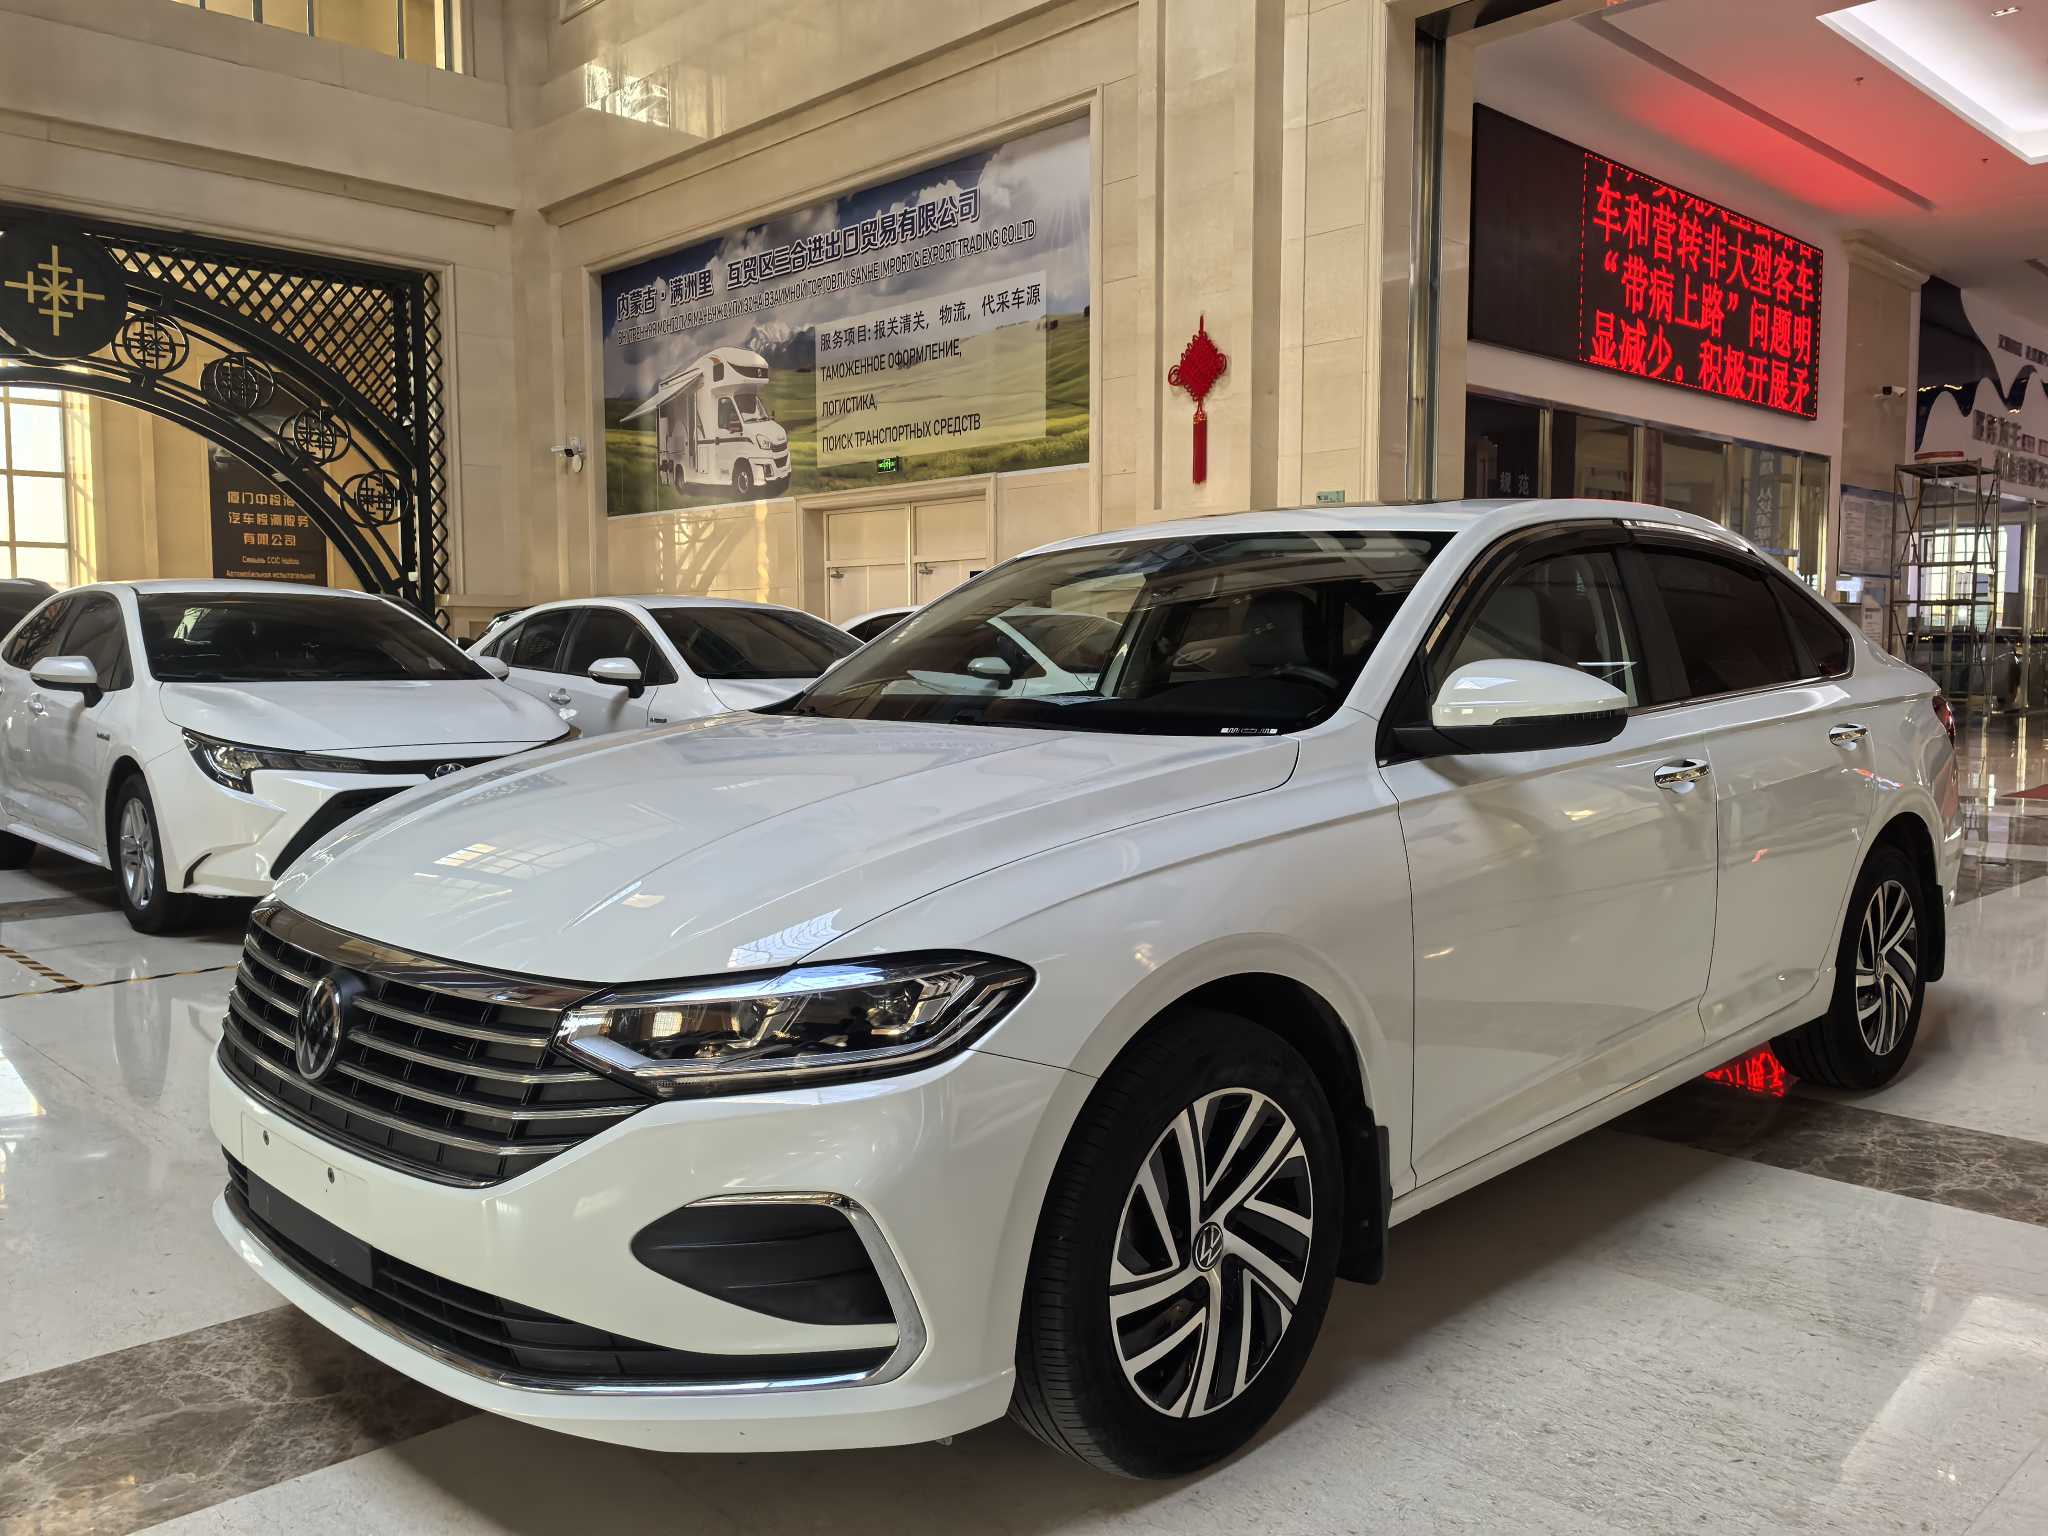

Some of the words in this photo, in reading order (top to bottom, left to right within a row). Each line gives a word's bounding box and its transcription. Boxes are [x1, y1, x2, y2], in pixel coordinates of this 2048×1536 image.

[727, 186, 981, 291] 互贸区三合进出口贸易有限公司
[743, 292, 762, 312] ЗОНА
[763, 278, 805, 307] ВЗАИМНОЙ
[807, 269, 848, 296] ТОРГОВЛИ
[850, 261, 878, 285] SANHE
[879, 252, 911, 278] IMPORT
[913, 249, 920, 268] &
[921, 239, 956, 266] EXPORT
[957, 228, 998, 257] TRADING
[1593, 180, 1814, 311] 车和营转非大型客车
[820, 354, 885, 382] ТАМОЖЕННОЕ
[888, 338, 962, 370] ОФОРМЛЕНИЕ,
[822, 393, 878, 417] ЛОГИСТИКА,
[822, 433, 853, 453] ПОИСК
[855, 420, 931, 448] ТРАНСПОРТНЫХ
[933, 413, 981, 437] СРЕДСТВ
